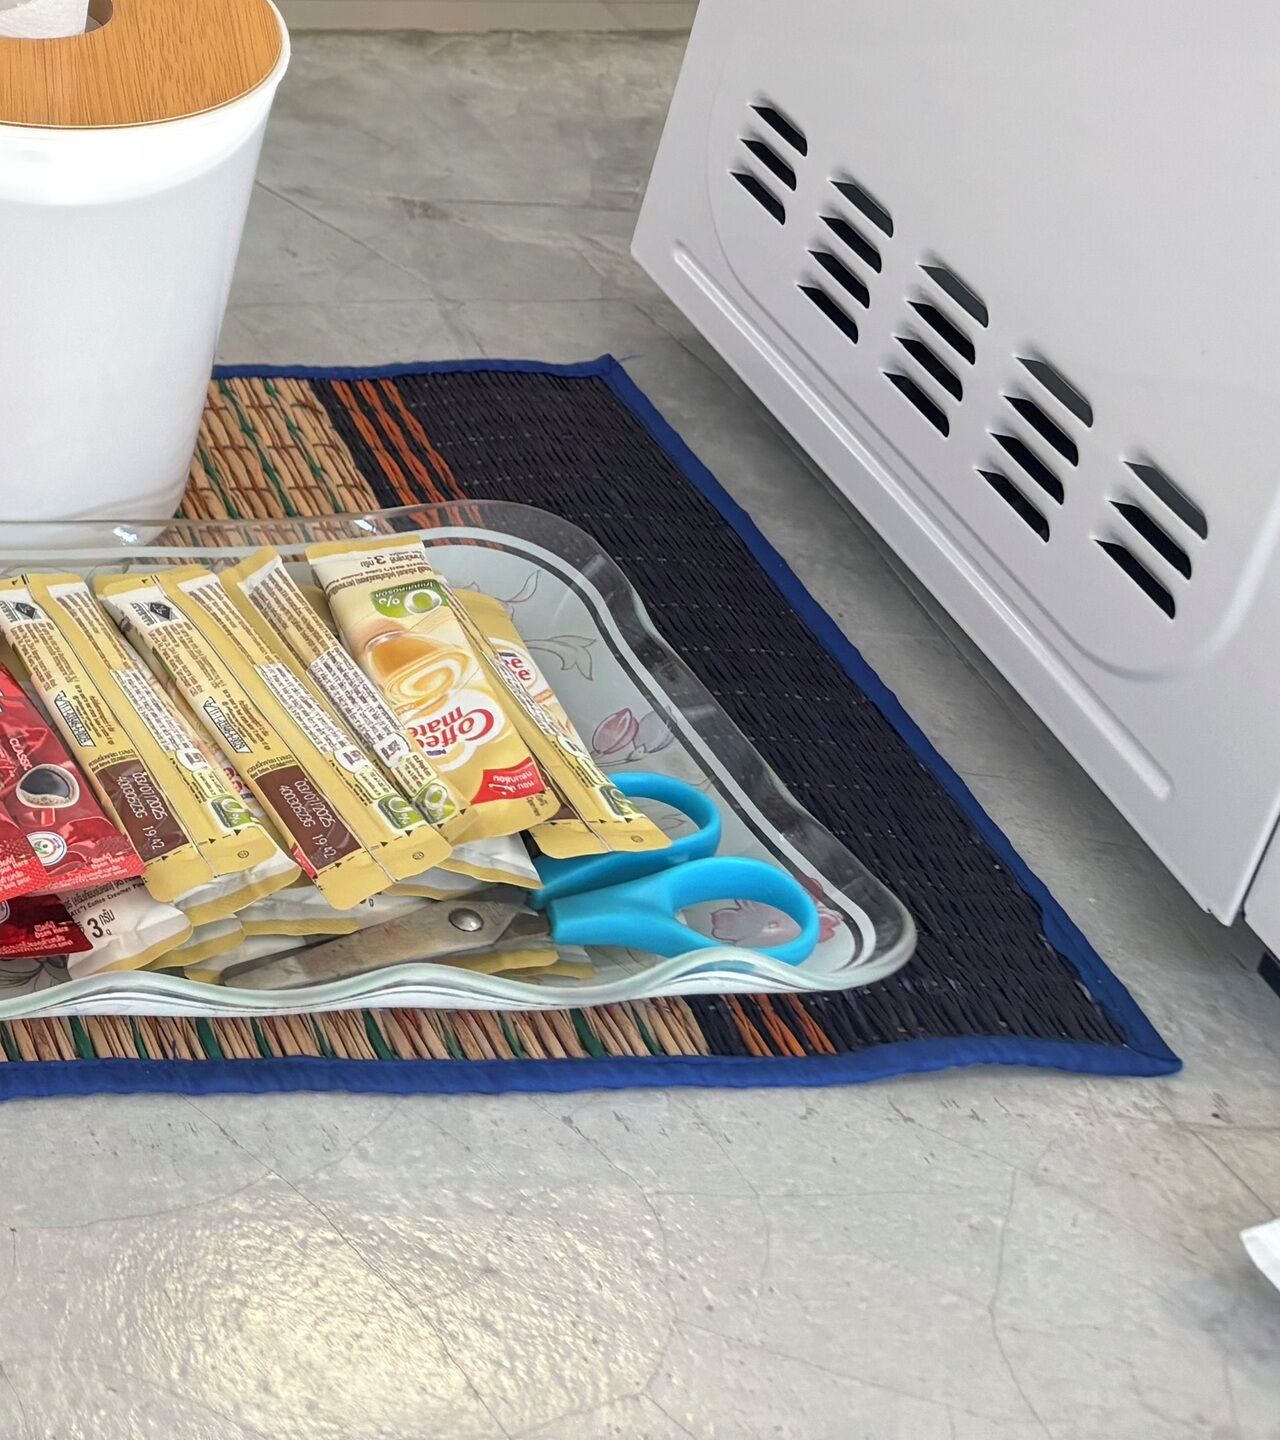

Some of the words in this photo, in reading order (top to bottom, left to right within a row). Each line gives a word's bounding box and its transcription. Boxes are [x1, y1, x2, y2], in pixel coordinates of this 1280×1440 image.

[7, 736, 34, 773] CLASSIC
[132, 770, 168, 821] 03/07/2025
[293, 778, 336, 829] 03/07/2025
[141, 823, 165, 851] 19:42
[311, 833, 336, 859] 19:42
[85, 916, 104, 939] 3
